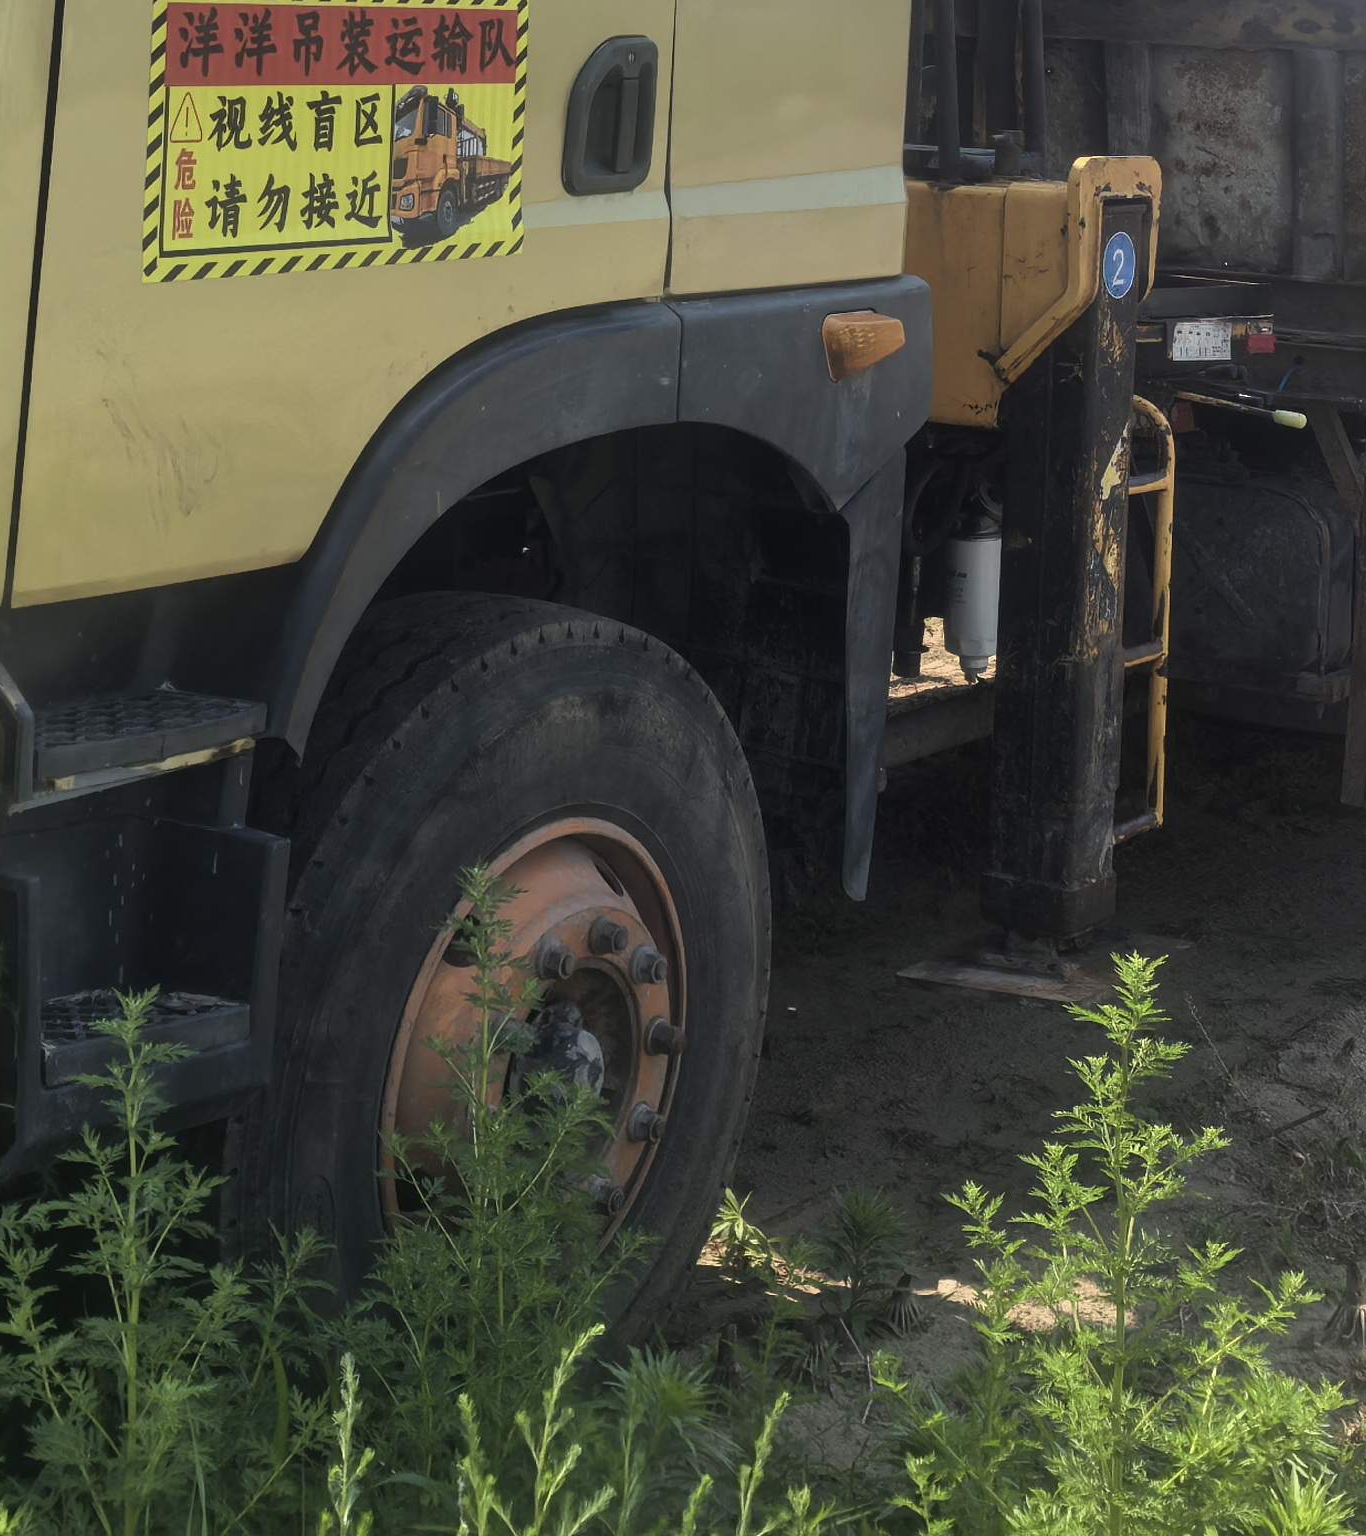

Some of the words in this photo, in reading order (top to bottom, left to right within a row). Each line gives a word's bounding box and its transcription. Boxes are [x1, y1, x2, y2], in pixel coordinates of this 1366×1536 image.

[178, 6, 517, 78] 洋洋吊装运输队
[207, 90, 384, 152] 视线盲区
[172, 148, 198, 241] 危险
[205, 170, 383, 238] 请勿接近
[1111, 249, 1124, 288] 2
